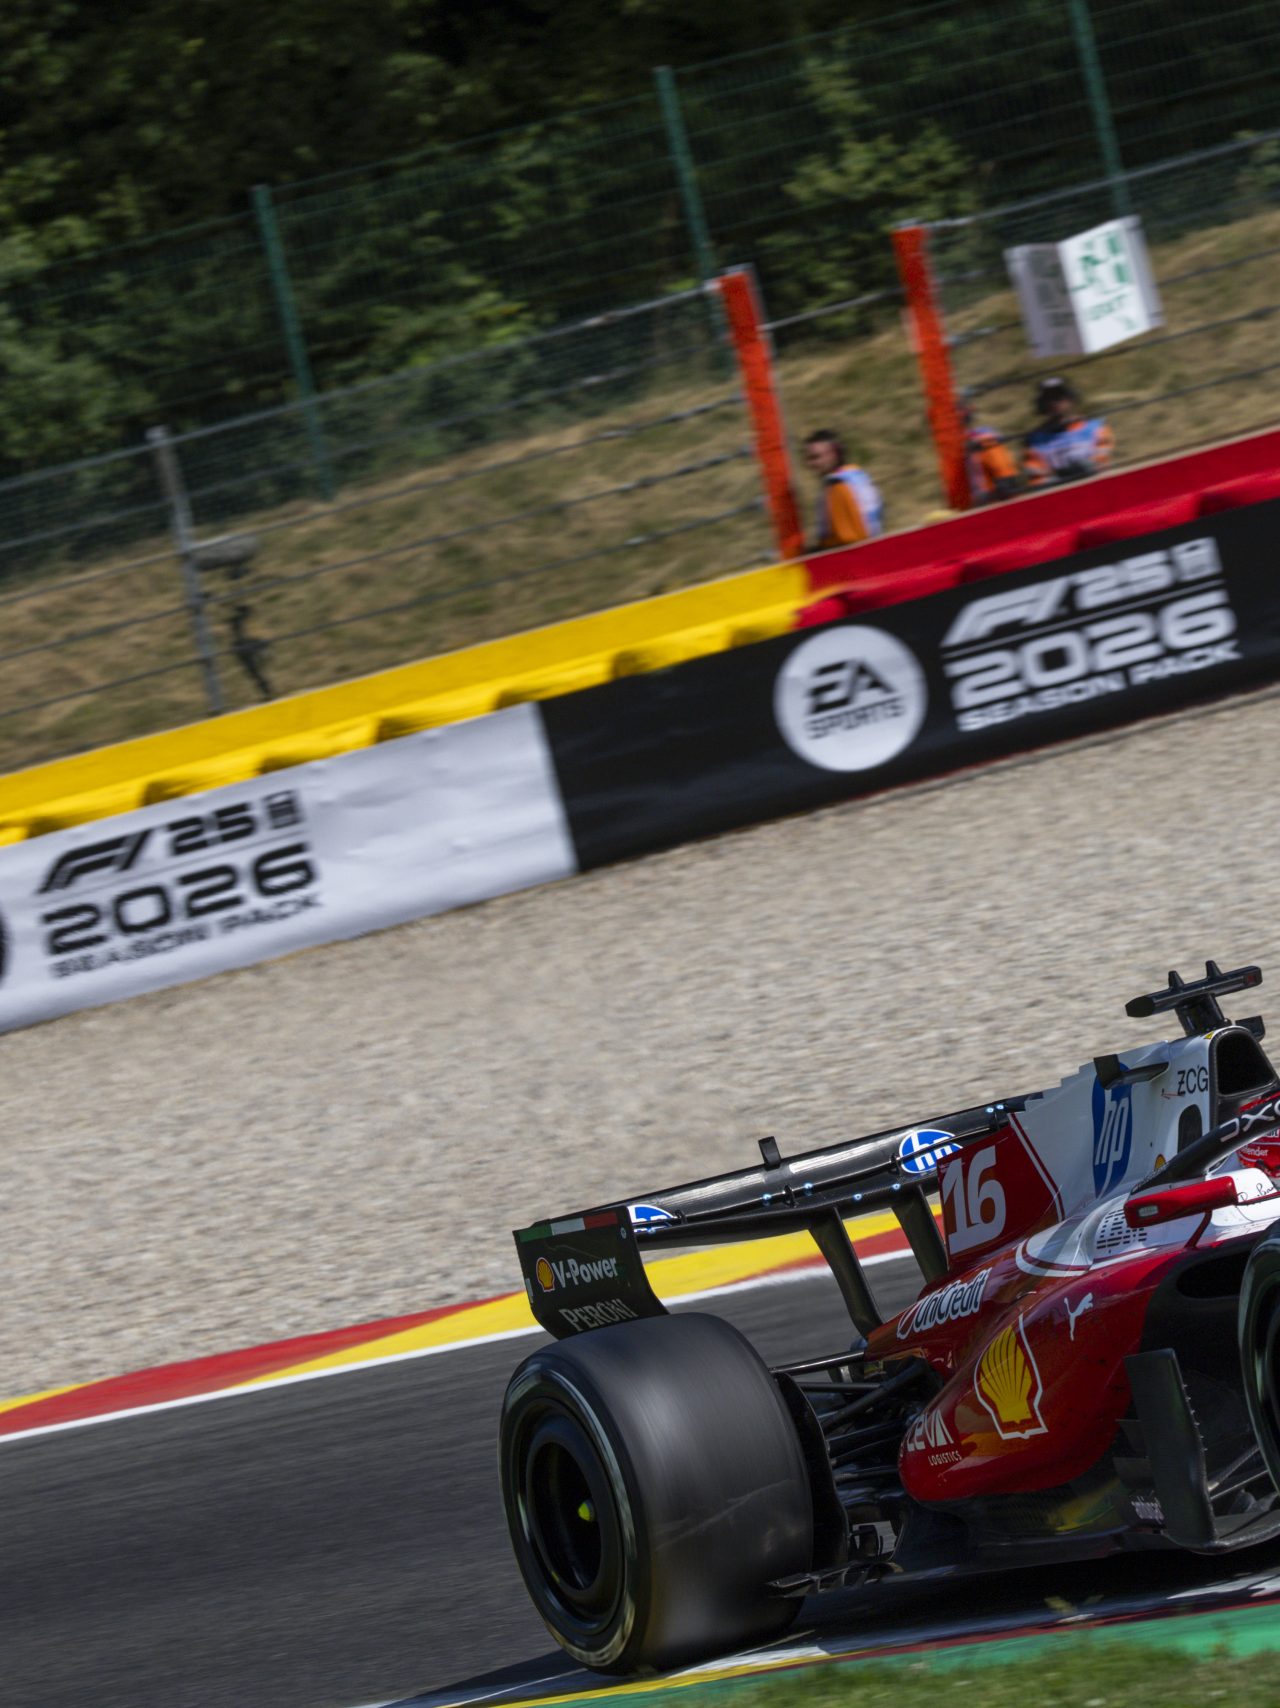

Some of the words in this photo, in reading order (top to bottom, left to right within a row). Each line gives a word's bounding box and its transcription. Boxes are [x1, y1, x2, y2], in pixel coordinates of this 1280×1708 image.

[1074, 550, 1176, 610] 25
[944, 590, 1238, 710] 2026
[807, 659, 897, 714] EA
[956, 670, 1127, 732] SEASON
[1130, 640, 1244, 686] PACK
[804, 698, 906, 739] SPORTS
[167, 802, 258, 856] 25
[41, 842, 320, 957] 2026
[51, 929, 210, 981] SEASON
[217, 892, 325, 936] PACK
[942, 1145, 1007, 1256] 16
[551, 1256, 619, 1289] V-Power
[913, 1267, 992, 1331] UniCredit
[558, 1298, 639, 1333] PERONI
[927, 1450, 963, 1467] LOGISTICS
